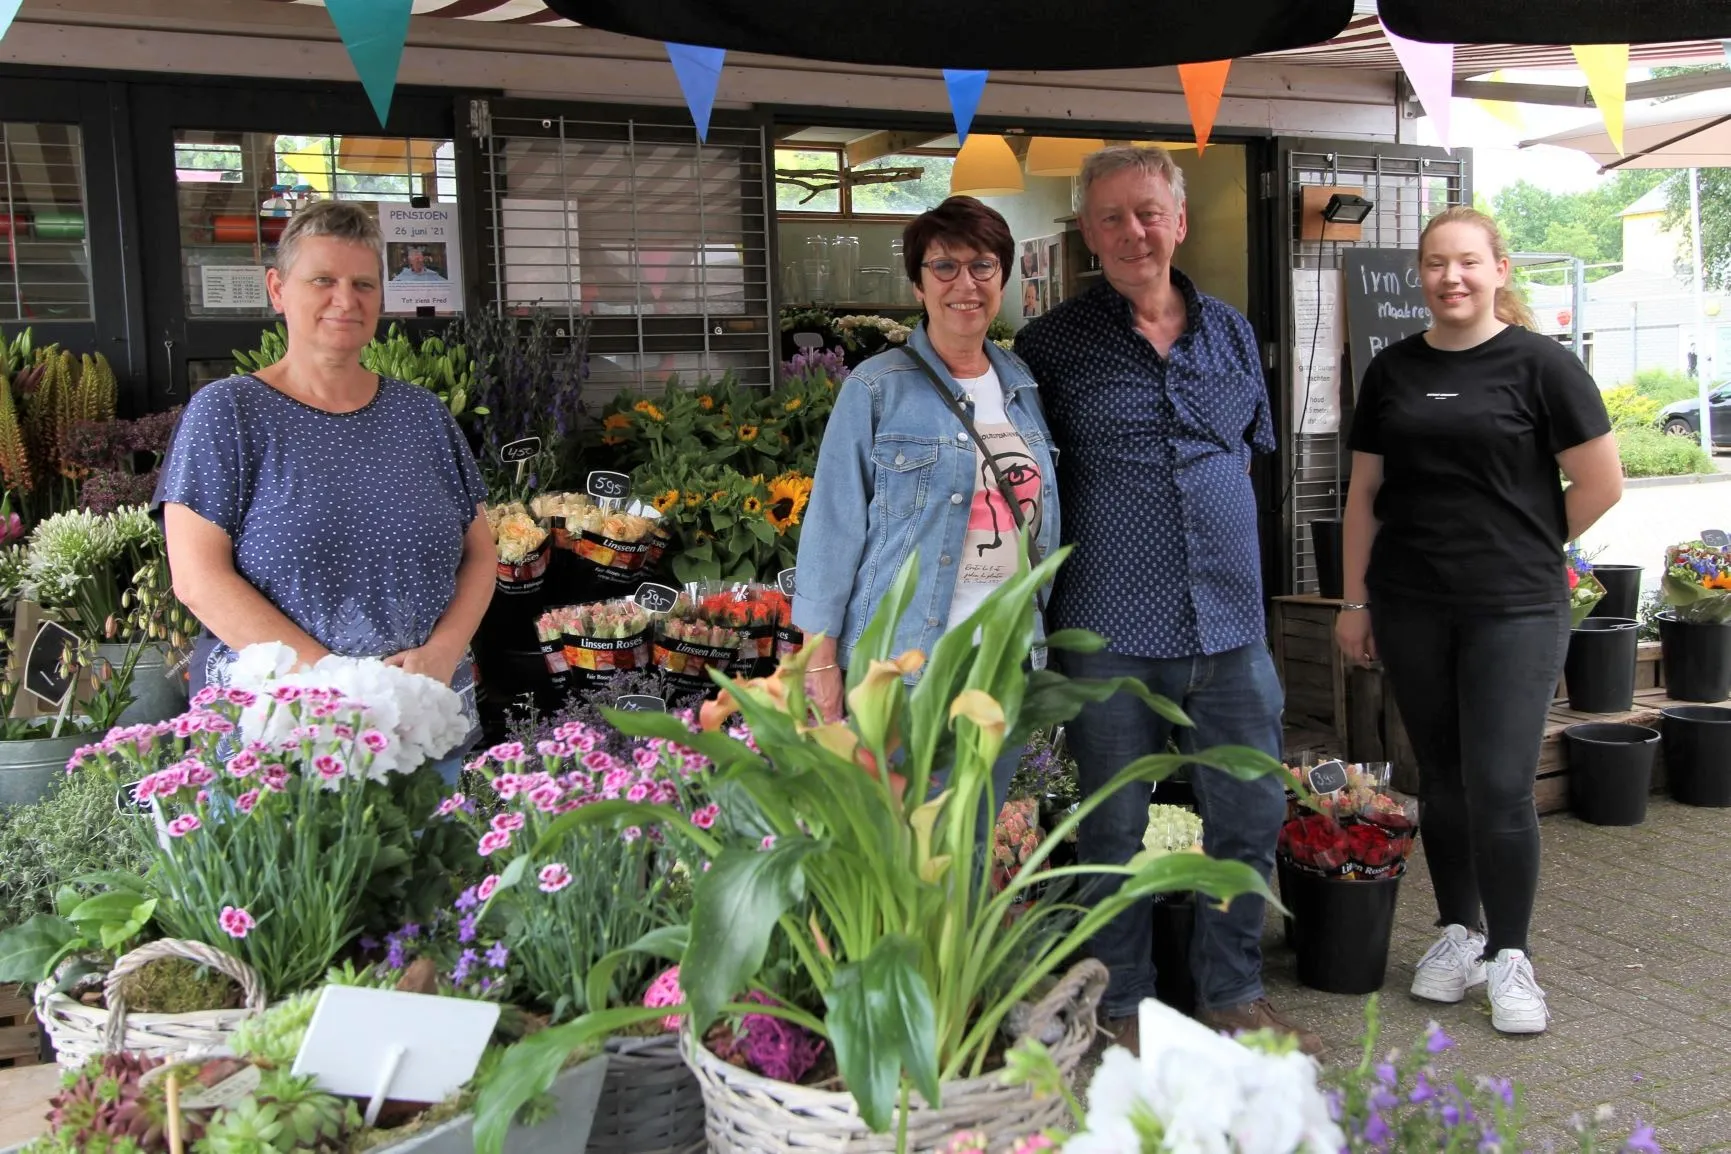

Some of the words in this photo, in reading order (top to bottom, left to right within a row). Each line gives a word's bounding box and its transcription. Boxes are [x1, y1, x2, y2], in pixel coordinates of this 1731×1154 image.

[390, 210, 448, 220] PENSIOEN
[395, 226, 407, 235] 26
[410, 226, 427, 237] juni
[595, 477, 623, 495] 595
[602, 538, 636, 553] Linssen
[641, 589, 671, 611] 595
[581, 638, 614, 650] Linssen
[616, 637, 643, 650] Roses
[675, 642, 709, 657] Linssen
[709, 648, 731, 659] Roses
[1364, 864, 1391, 876] Roses
